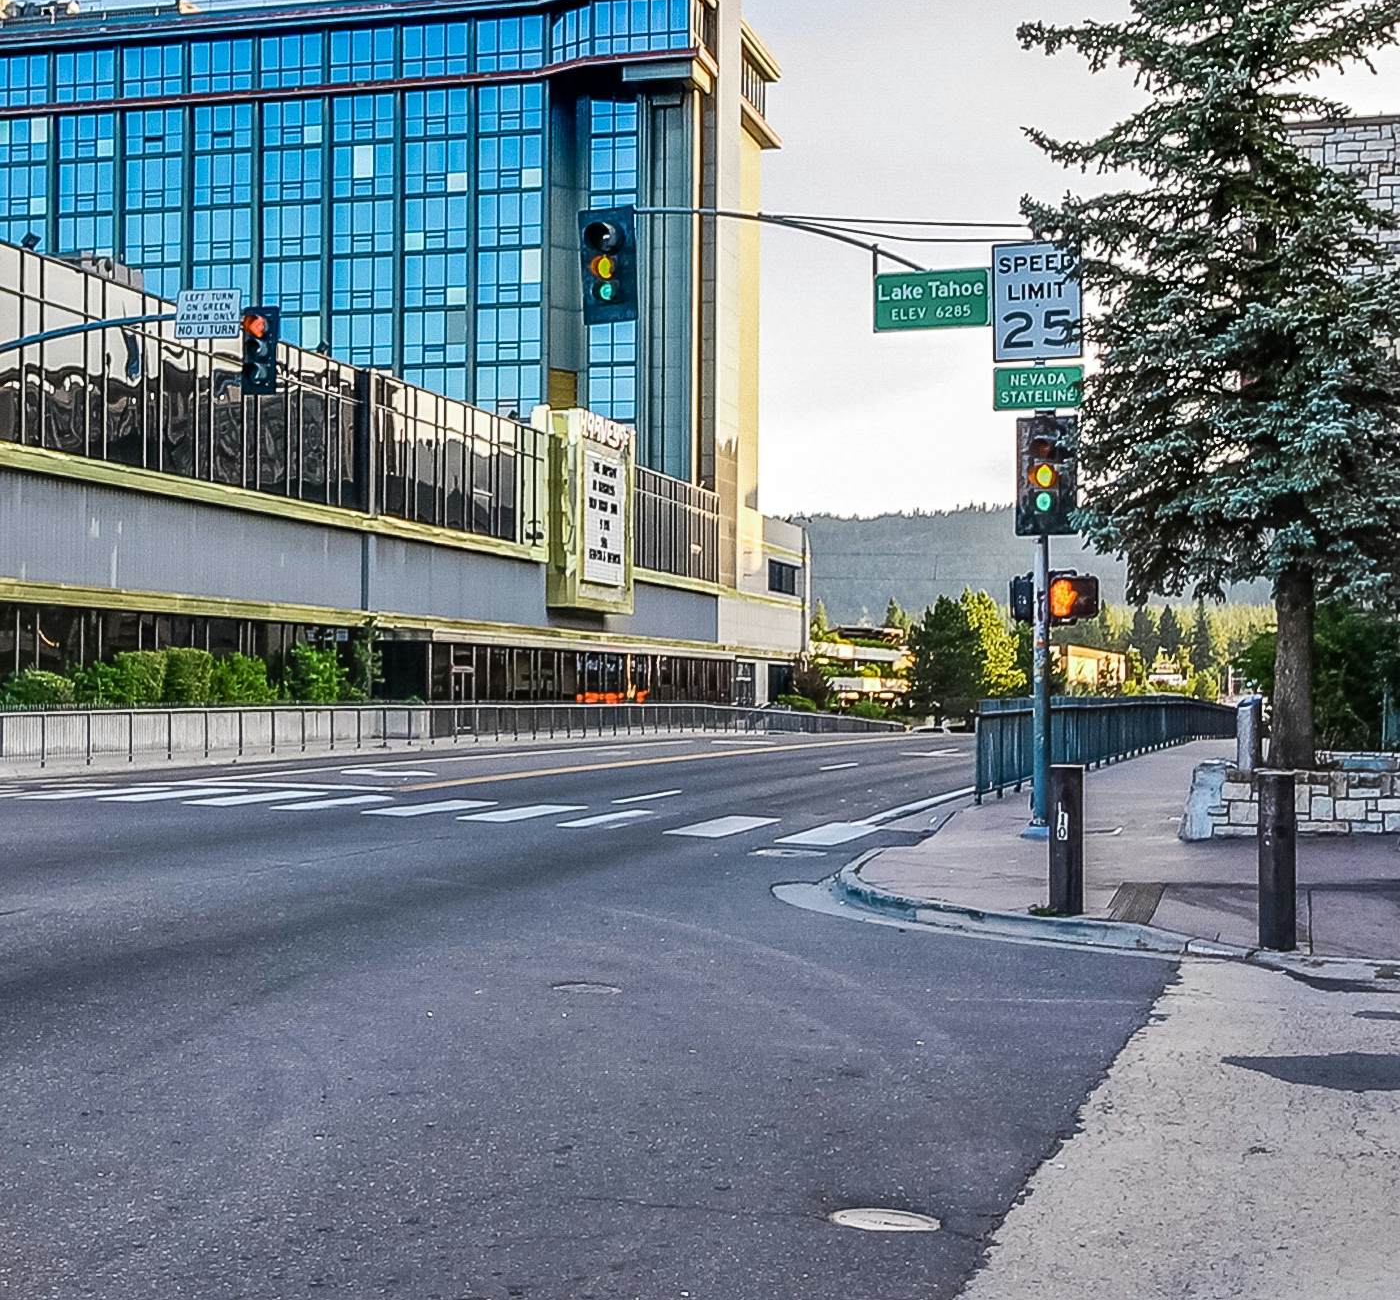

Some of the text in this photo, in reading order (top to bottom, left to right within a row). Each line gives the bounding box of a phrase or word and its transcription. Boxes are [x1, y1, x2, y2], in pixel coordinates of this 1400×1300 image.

[999, 253, 1074, 274] SPEED
[185, 292, 234, 301] LEFT TURN
[878, 280, 984, 301] Lake Tahoe
[1007, 281, 1066, 301] LIMIT
[186, 303, 231, 311] ON GREEN
[891, 304, 971, 321] ELEV 6285
[181, 312, 236, 321] ARROW ONLY
[178, 325, 236, 335] NO U TURN
[1002, 308, 1073, 349] 25
[1010, 373, 1067, 386] NEVADA
[1001, 388, 1075, 404] STATELINE
